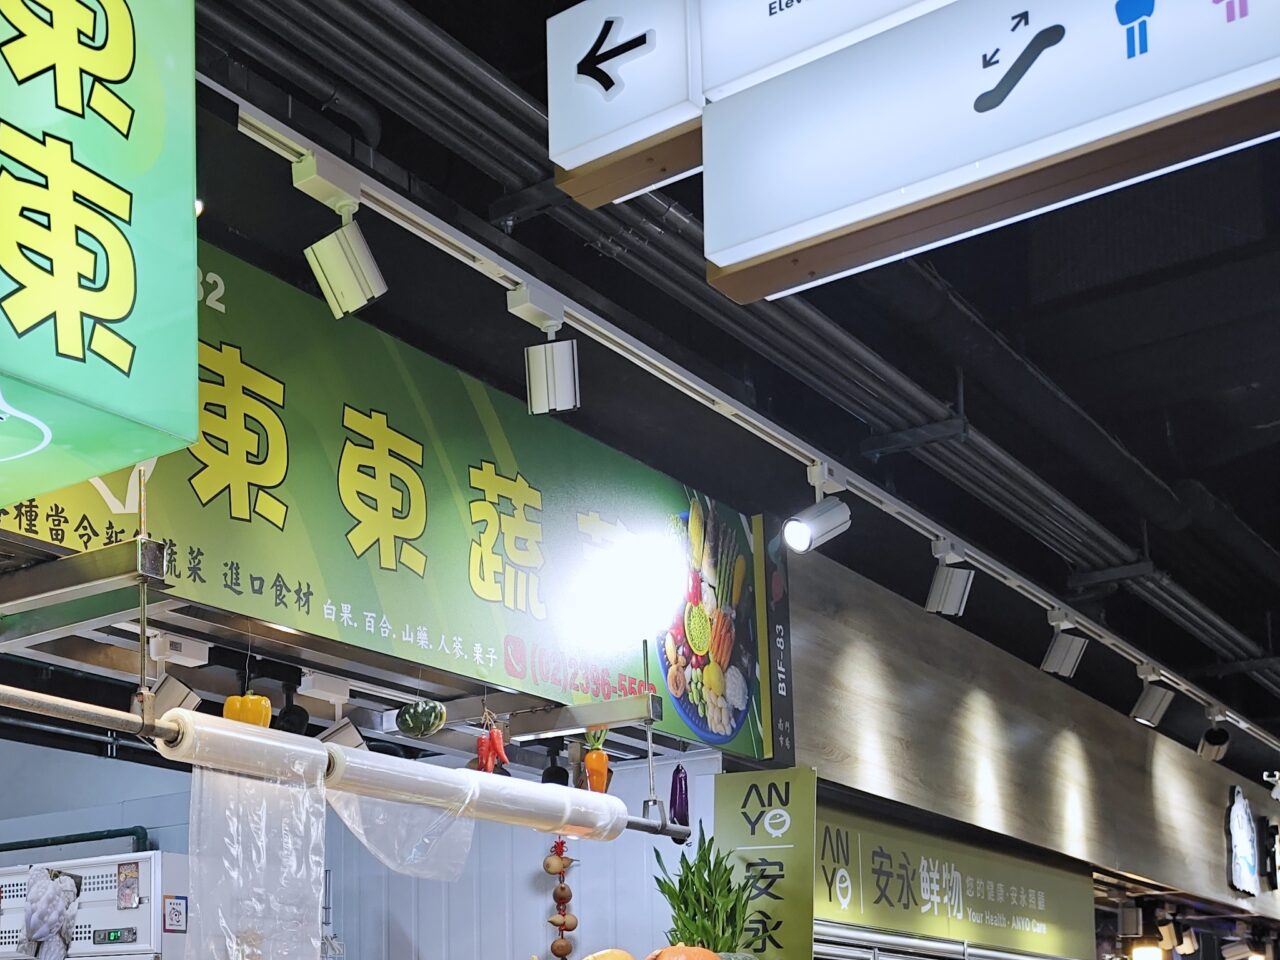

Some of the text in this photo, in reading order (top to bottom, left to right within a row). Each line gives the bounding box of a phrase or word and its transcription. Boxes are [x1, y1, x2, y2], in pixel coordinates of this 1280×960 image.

[222, 560, 314, 616] 進口食材
[776, 624, 786, 696] B1F-83
[871, 846, 963, 921] 安永鮮物
[967, 907, 984, 924] Your
[1012, 915, 1031, 932] ANYO
